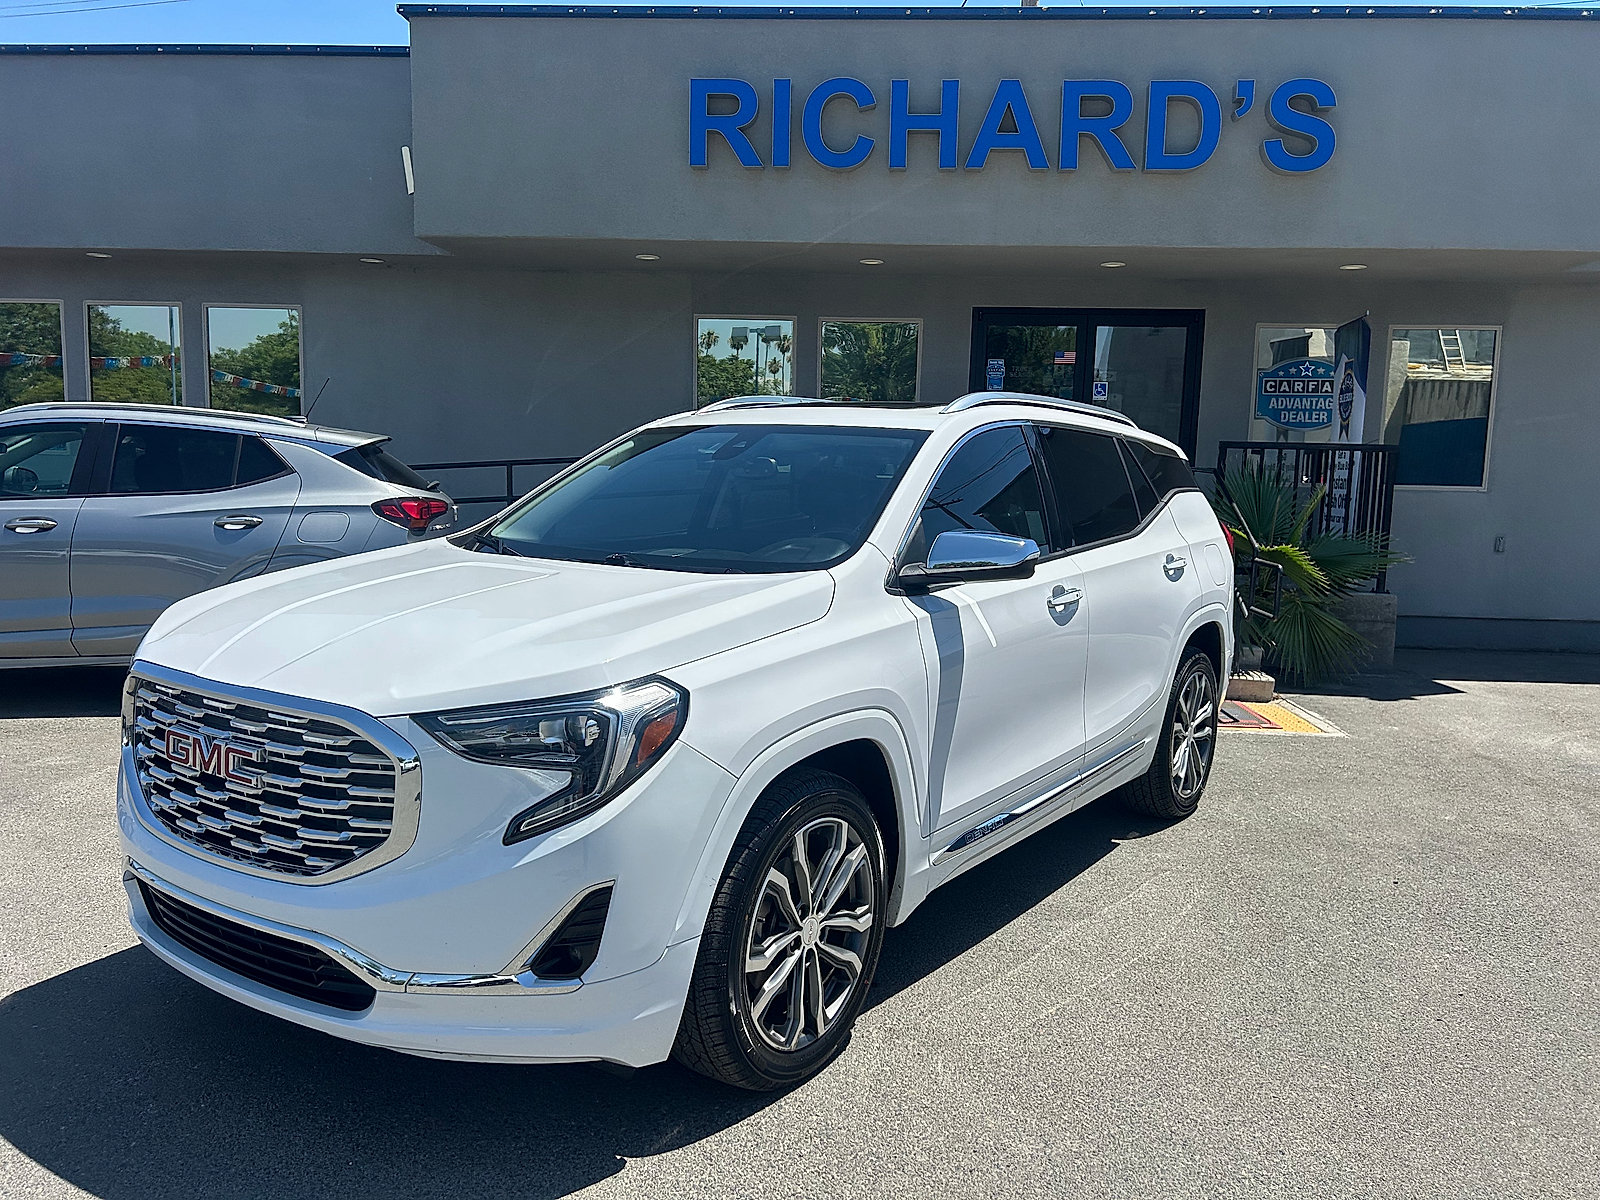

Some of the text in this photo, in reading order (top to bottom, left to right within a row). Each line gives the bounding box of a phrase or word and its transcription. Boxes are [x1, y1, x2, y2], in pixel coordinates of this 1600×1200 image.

[1265, 381, 1333, 392] CARFA
[1268, 397, 1334, 409] ADVANTAG
[1280, 411, 1328, 423] DEALER
[165, 725, 262, 788] GMC
